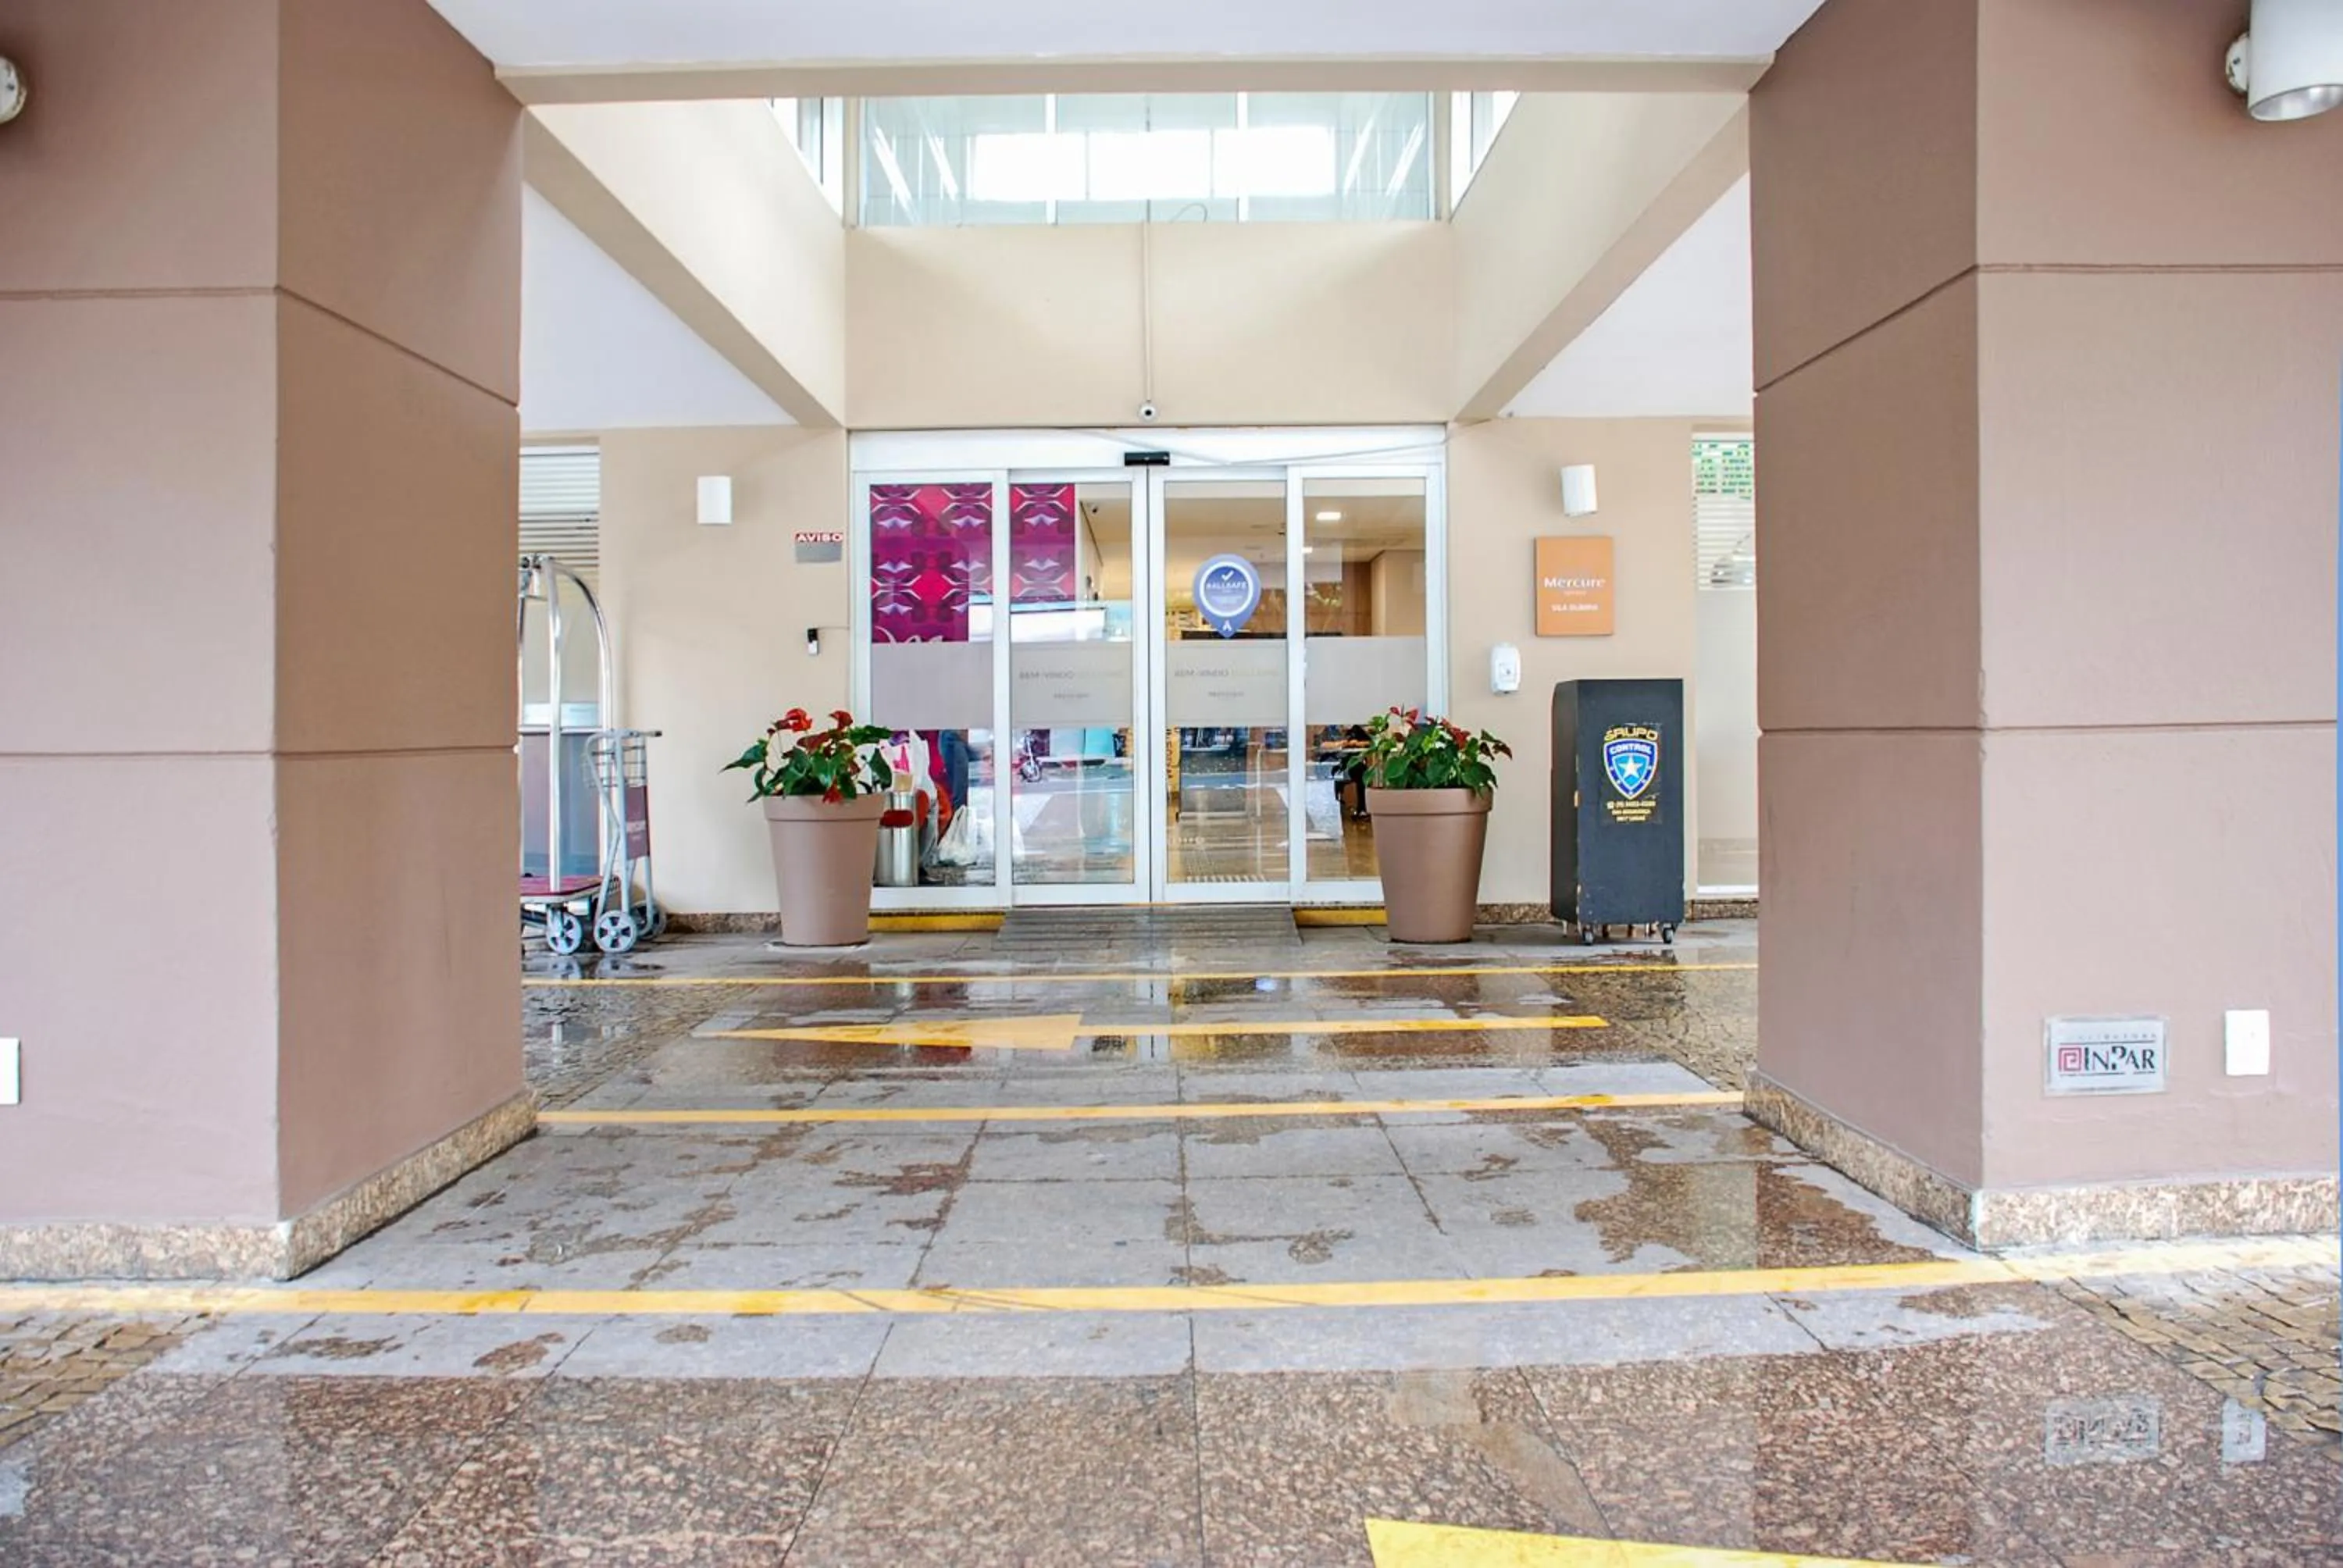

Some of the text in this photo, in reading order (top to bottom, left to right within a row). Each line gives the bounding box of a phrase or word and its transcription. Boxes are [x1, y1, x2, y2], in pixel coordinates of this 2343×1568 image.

[1544, 578, 1606, 588] Mercure
[1604, 727, 1658, 741] GRUPO
[1610, 743, 1653, 755] CONTROL
